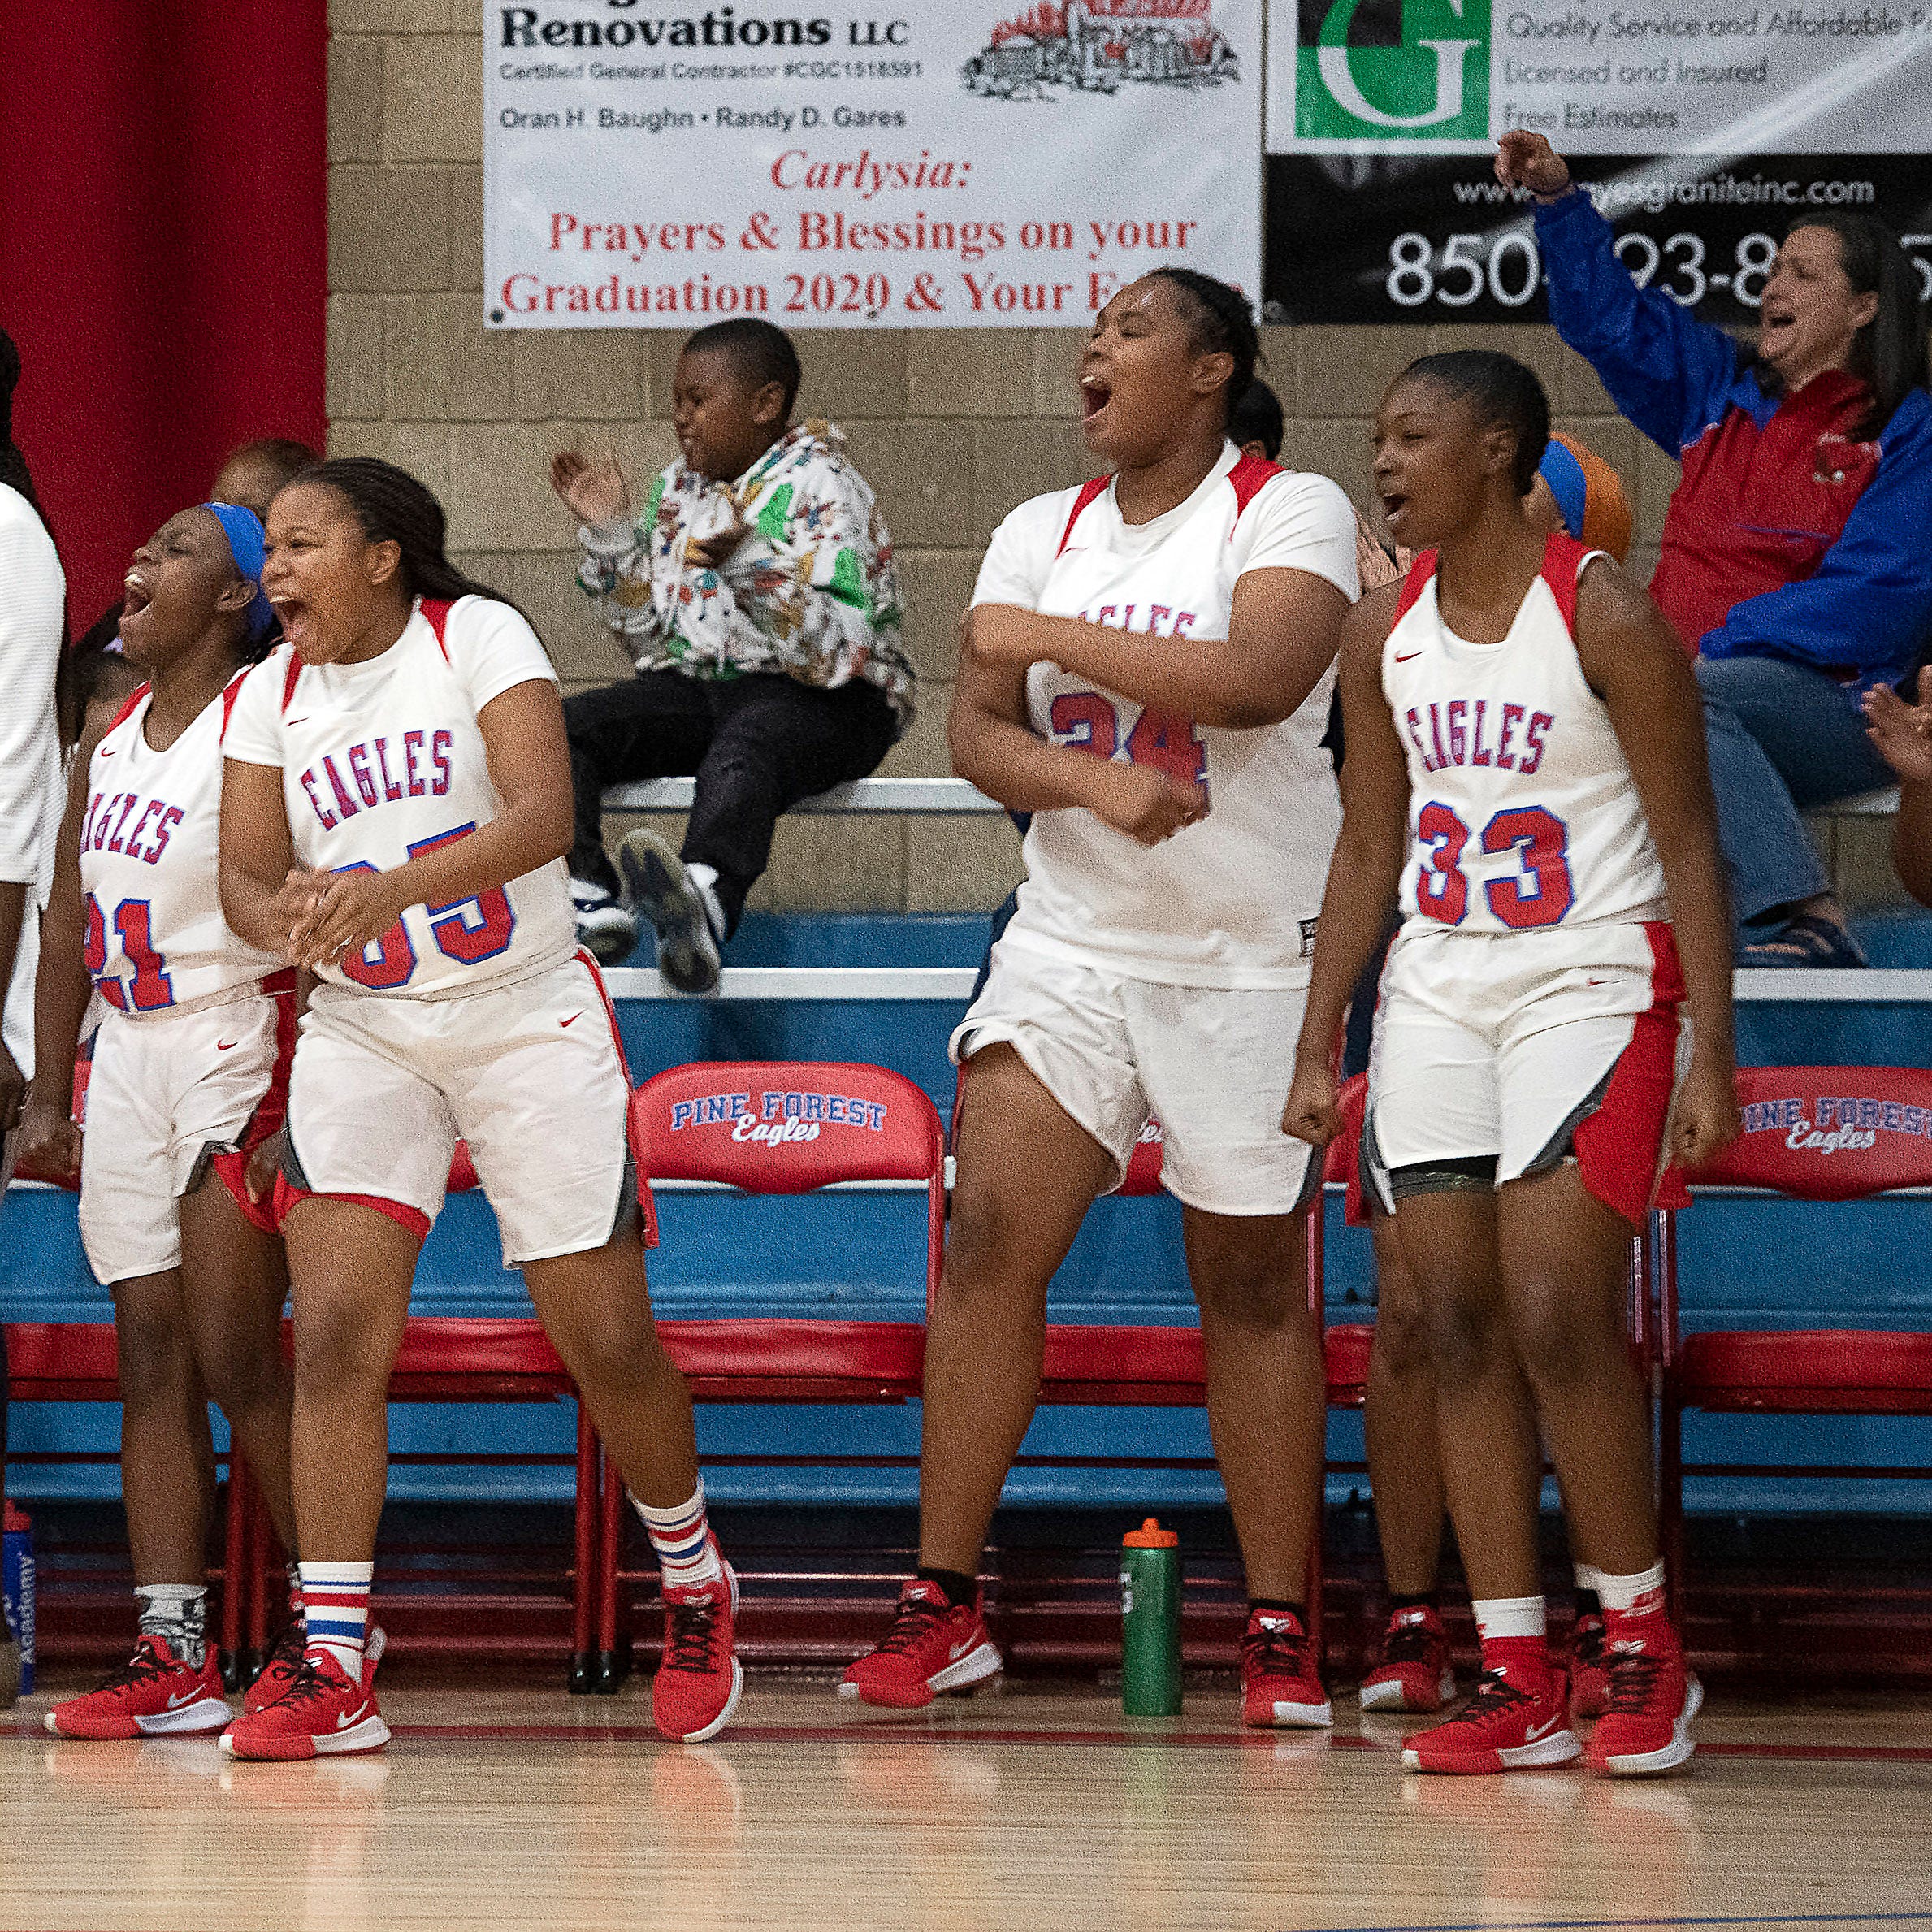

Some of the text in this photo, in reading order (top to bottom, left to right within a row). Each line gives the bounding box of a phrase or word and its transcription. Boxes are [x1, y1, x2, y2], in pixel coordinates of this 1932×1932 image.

[500, 6, 911, 47] Renovations LLC
[1507, 11, 1601, 44] Quality
[1609, 10, 1700, 37] Service
[1709, 10, 1759, 37] and
[1766, 8, 1904, 37] Affordable
[500, 62, 584, 80] Certified
[588, 62, 667, 80] General
[671, 62, 778, 80] Contractor
[1505, 56, 1768, 82] Licensed and Insured
[500, 106, 560, 129] Oran
[598, 106, 694, 134] Baughn
[716, 106, 795, 132] Randy
[832, 106, 907, 128] Gares
[1505, 102, 1679, 128] Free Estimates
[771, 149, 972, 200] Carlysia:
[549, 210, 1198, 262] Prayers & Blessings on your
[500, 273, 769, 314] Graduation
[784, 273, 891, 315] 2020
[903, 272, 943, 313] &
[961, 272, 1072, 312] Your
[1405, 700, 1555, 776] EAGLES
[299, 730, 453, 832] EAGLES
[1416, 799, 1576, 929] 33
[670, 1090, 888, 1132] PINE FOREST
[730, 1113, 821, 1147] Eagles
[1739, 1096, 1932, 1141] INE FORES
[1785, 1120, 1878, 1155] Eagles
